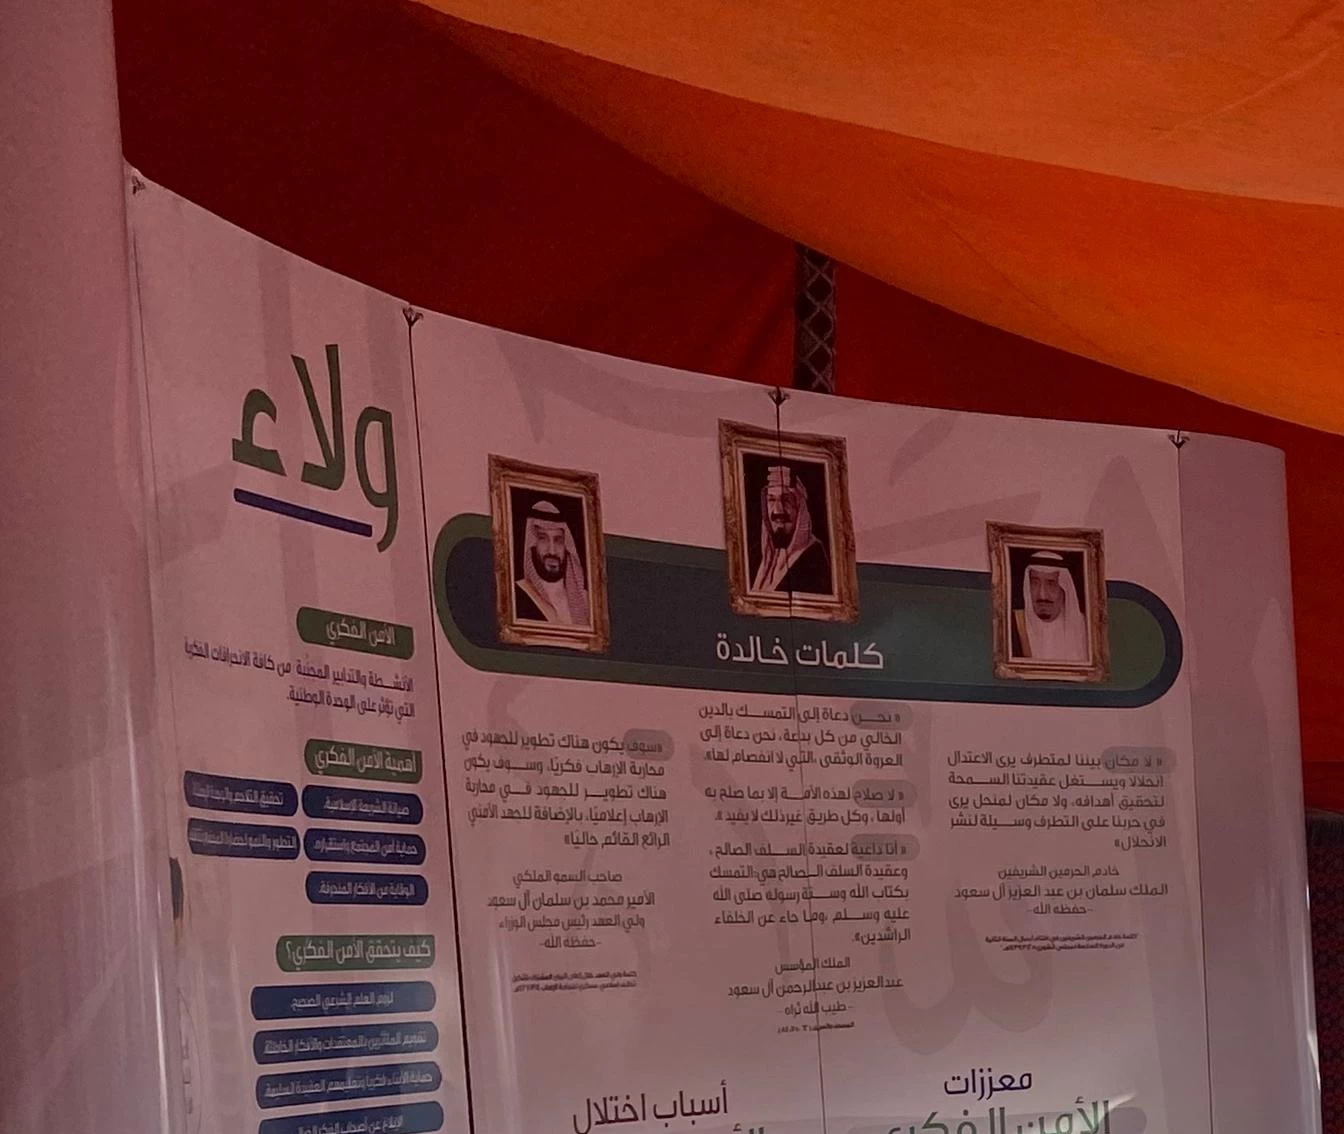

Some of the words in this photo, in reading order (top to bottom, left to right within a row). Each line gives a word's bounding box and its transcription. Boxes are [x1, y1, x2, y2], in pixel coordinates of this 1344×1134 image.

[232, 343, 397, 552] ولاء
[326, 619, 366, 645] الفكري
[368, 622, 395, 647] الأمن
[716, 632, 789, 665] خالدة
[795, 640, 884, 669] كلمات
[998, 864, 1046, 879] الشريفين
[1049, 865, 1090, 879] الحرمين
[1092, 865, 1119, 878] خادم
[954, 889, 989, 900] سعود
[992, 883, 1005, 901] آل
[1009, 885, 1040, 900] العزيز
[1067, 888, 1083, 900] بن
[1086, 884, 1126, 899] سلمان
[1129, 884, 1168, 896] الملك
[286, 939, 333, 970] الفكري؟
[336, 939, 363, 963] الأمن
[366, 941, 401, 963] يتحقق
[403, 941, 431, 961] كيف
[944, 1066, 1032, 1101] معززات
[653, 1079, 728, 1128] أسباب
